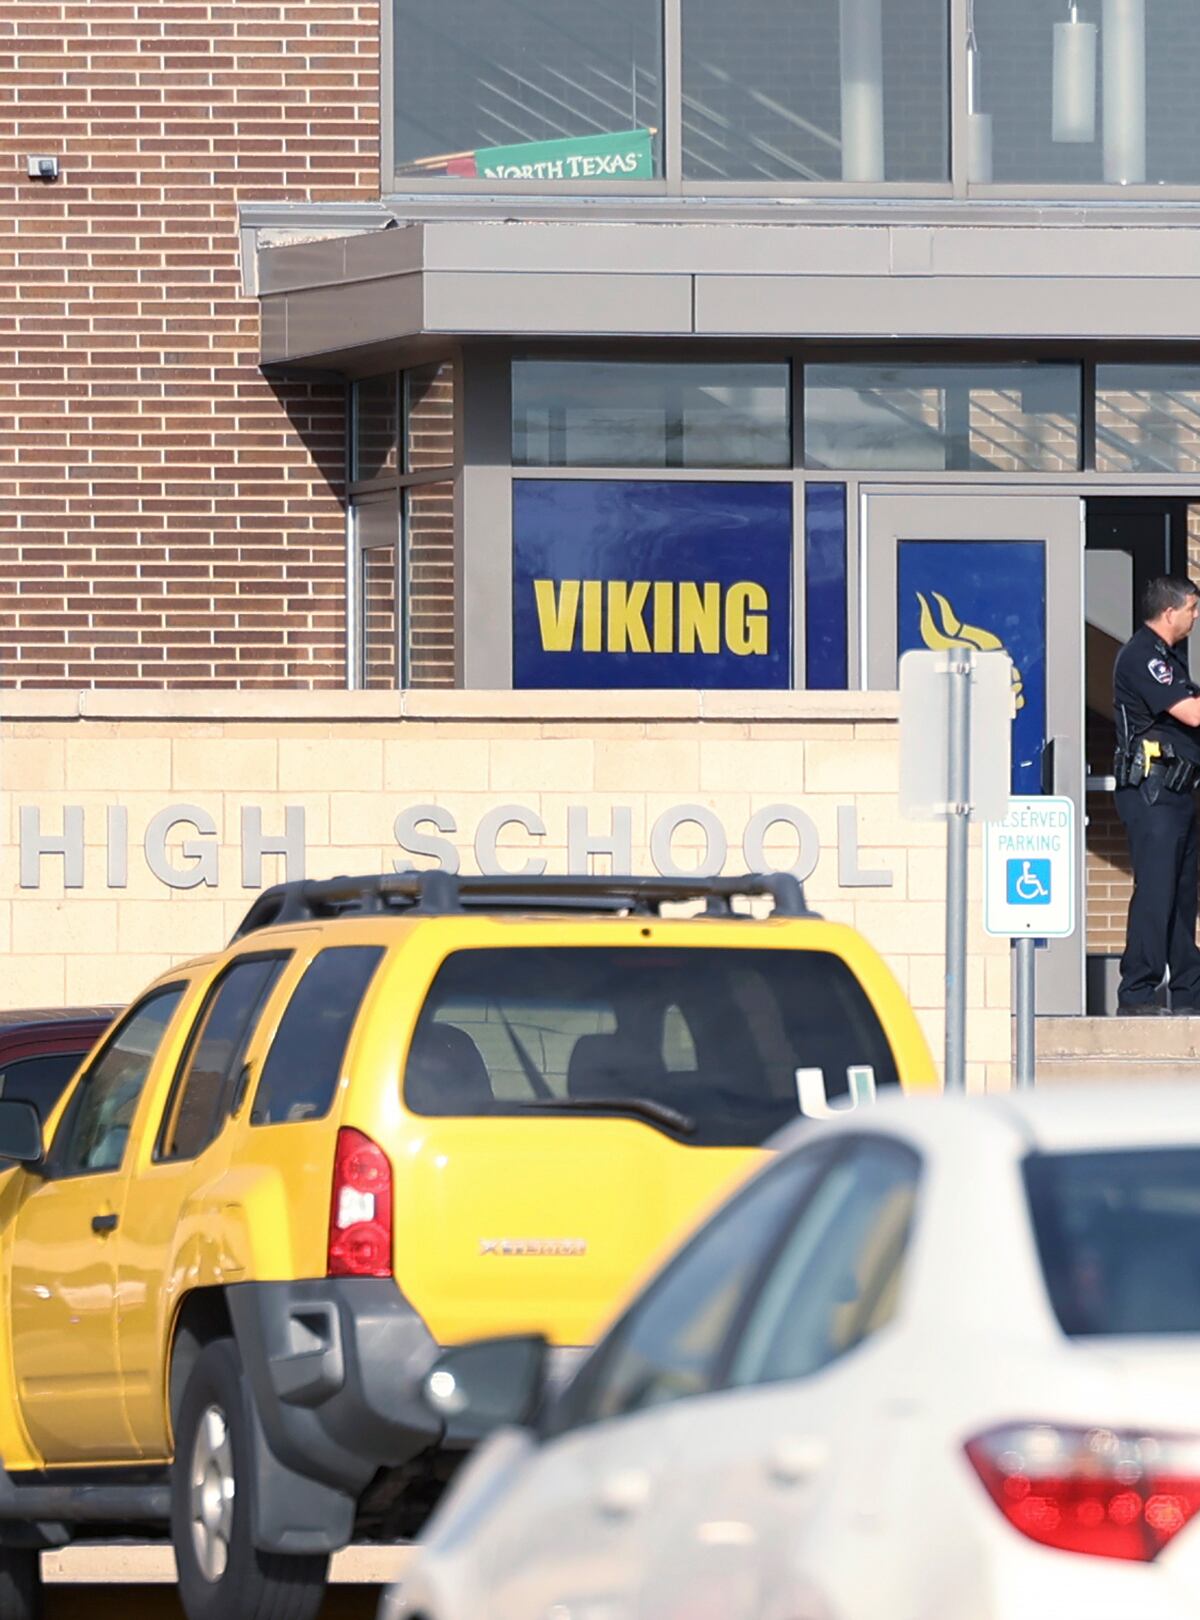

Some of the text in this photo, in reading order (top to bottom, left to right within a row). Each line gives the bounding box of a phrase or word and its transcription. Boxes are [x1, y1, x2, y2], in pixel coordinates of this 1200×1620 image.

[533, 579, 768, 656] VIKING
[19, 804, 893, 889] HIGH SCHOOL
[998, 835, 1061, 852] PARKING
